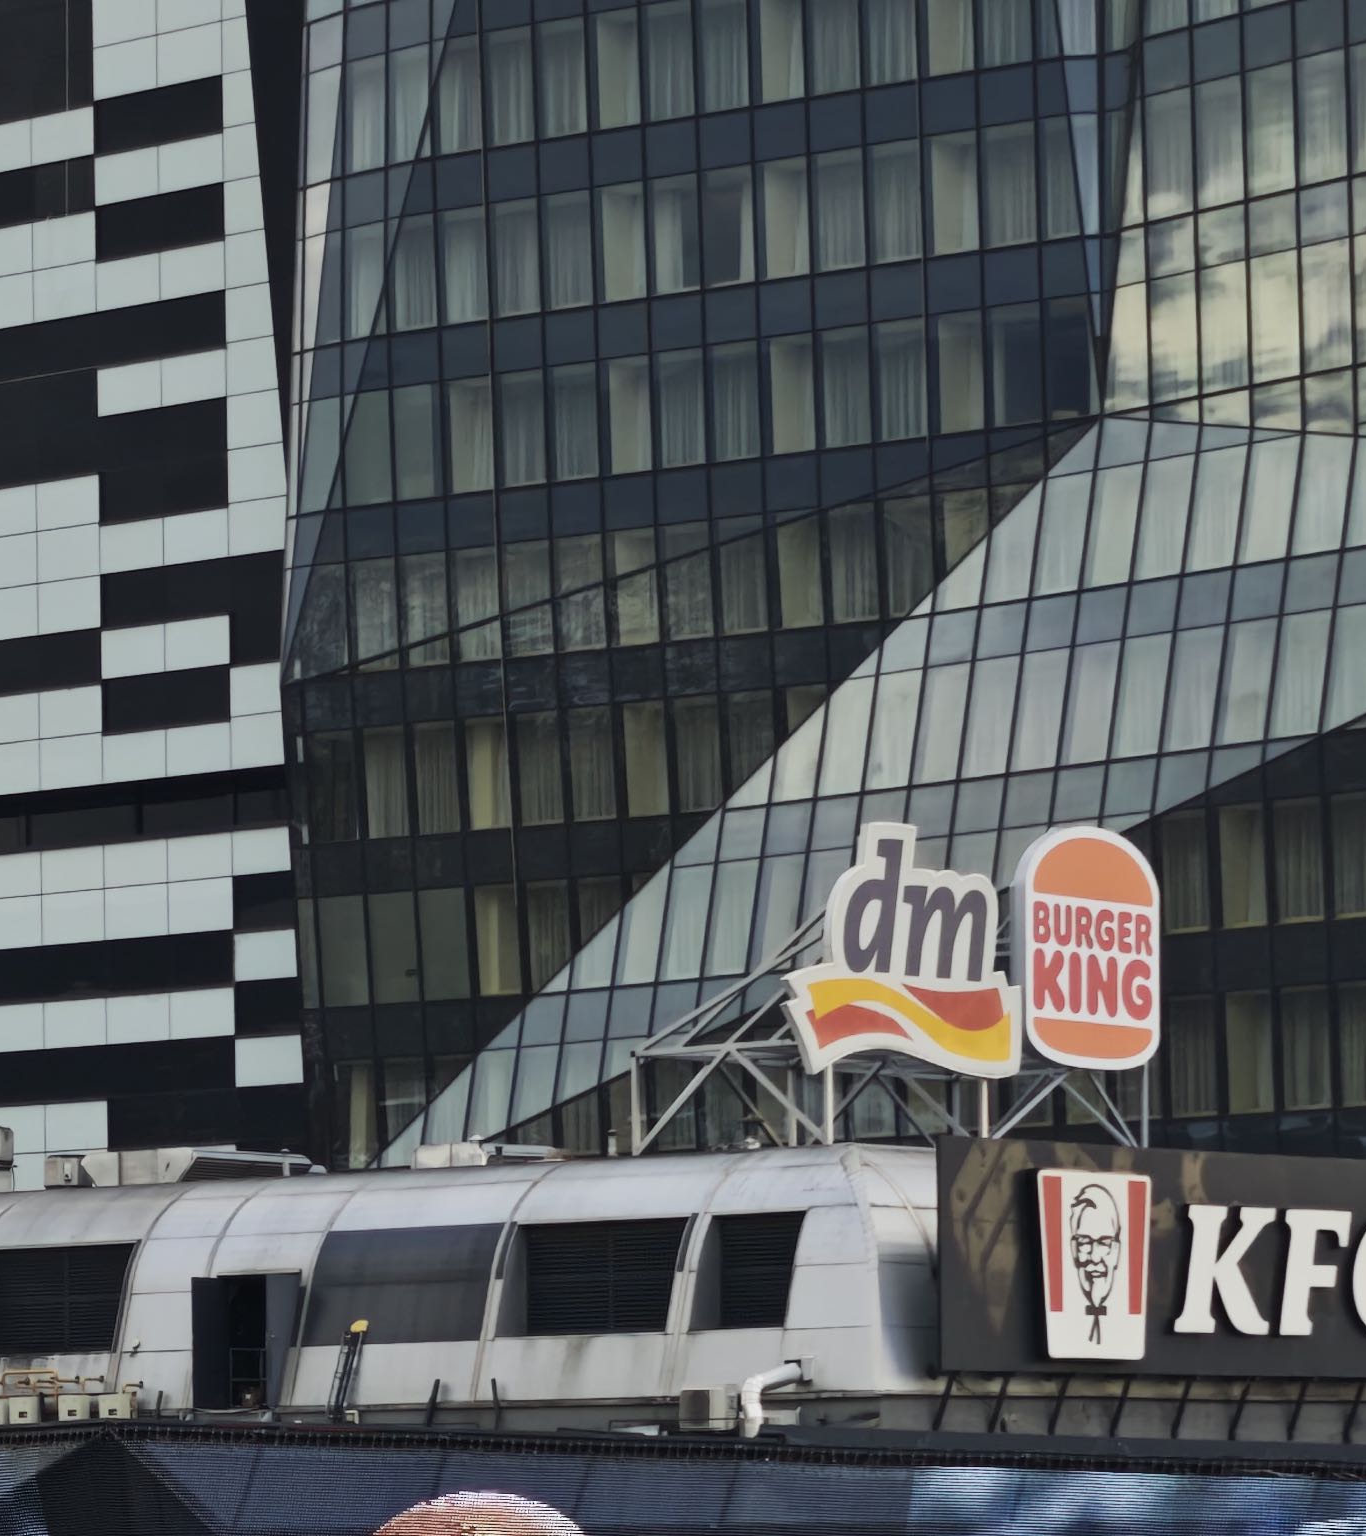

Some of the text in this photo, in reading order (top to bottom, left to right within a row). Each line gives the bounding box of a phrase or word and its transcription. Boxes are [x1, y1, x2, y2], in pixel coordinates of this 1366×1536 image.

[843, 838, 987, 982] dm
[1033, 900, 1153, 956] BURGER
[1033, 948, 1153, 1021] KING
